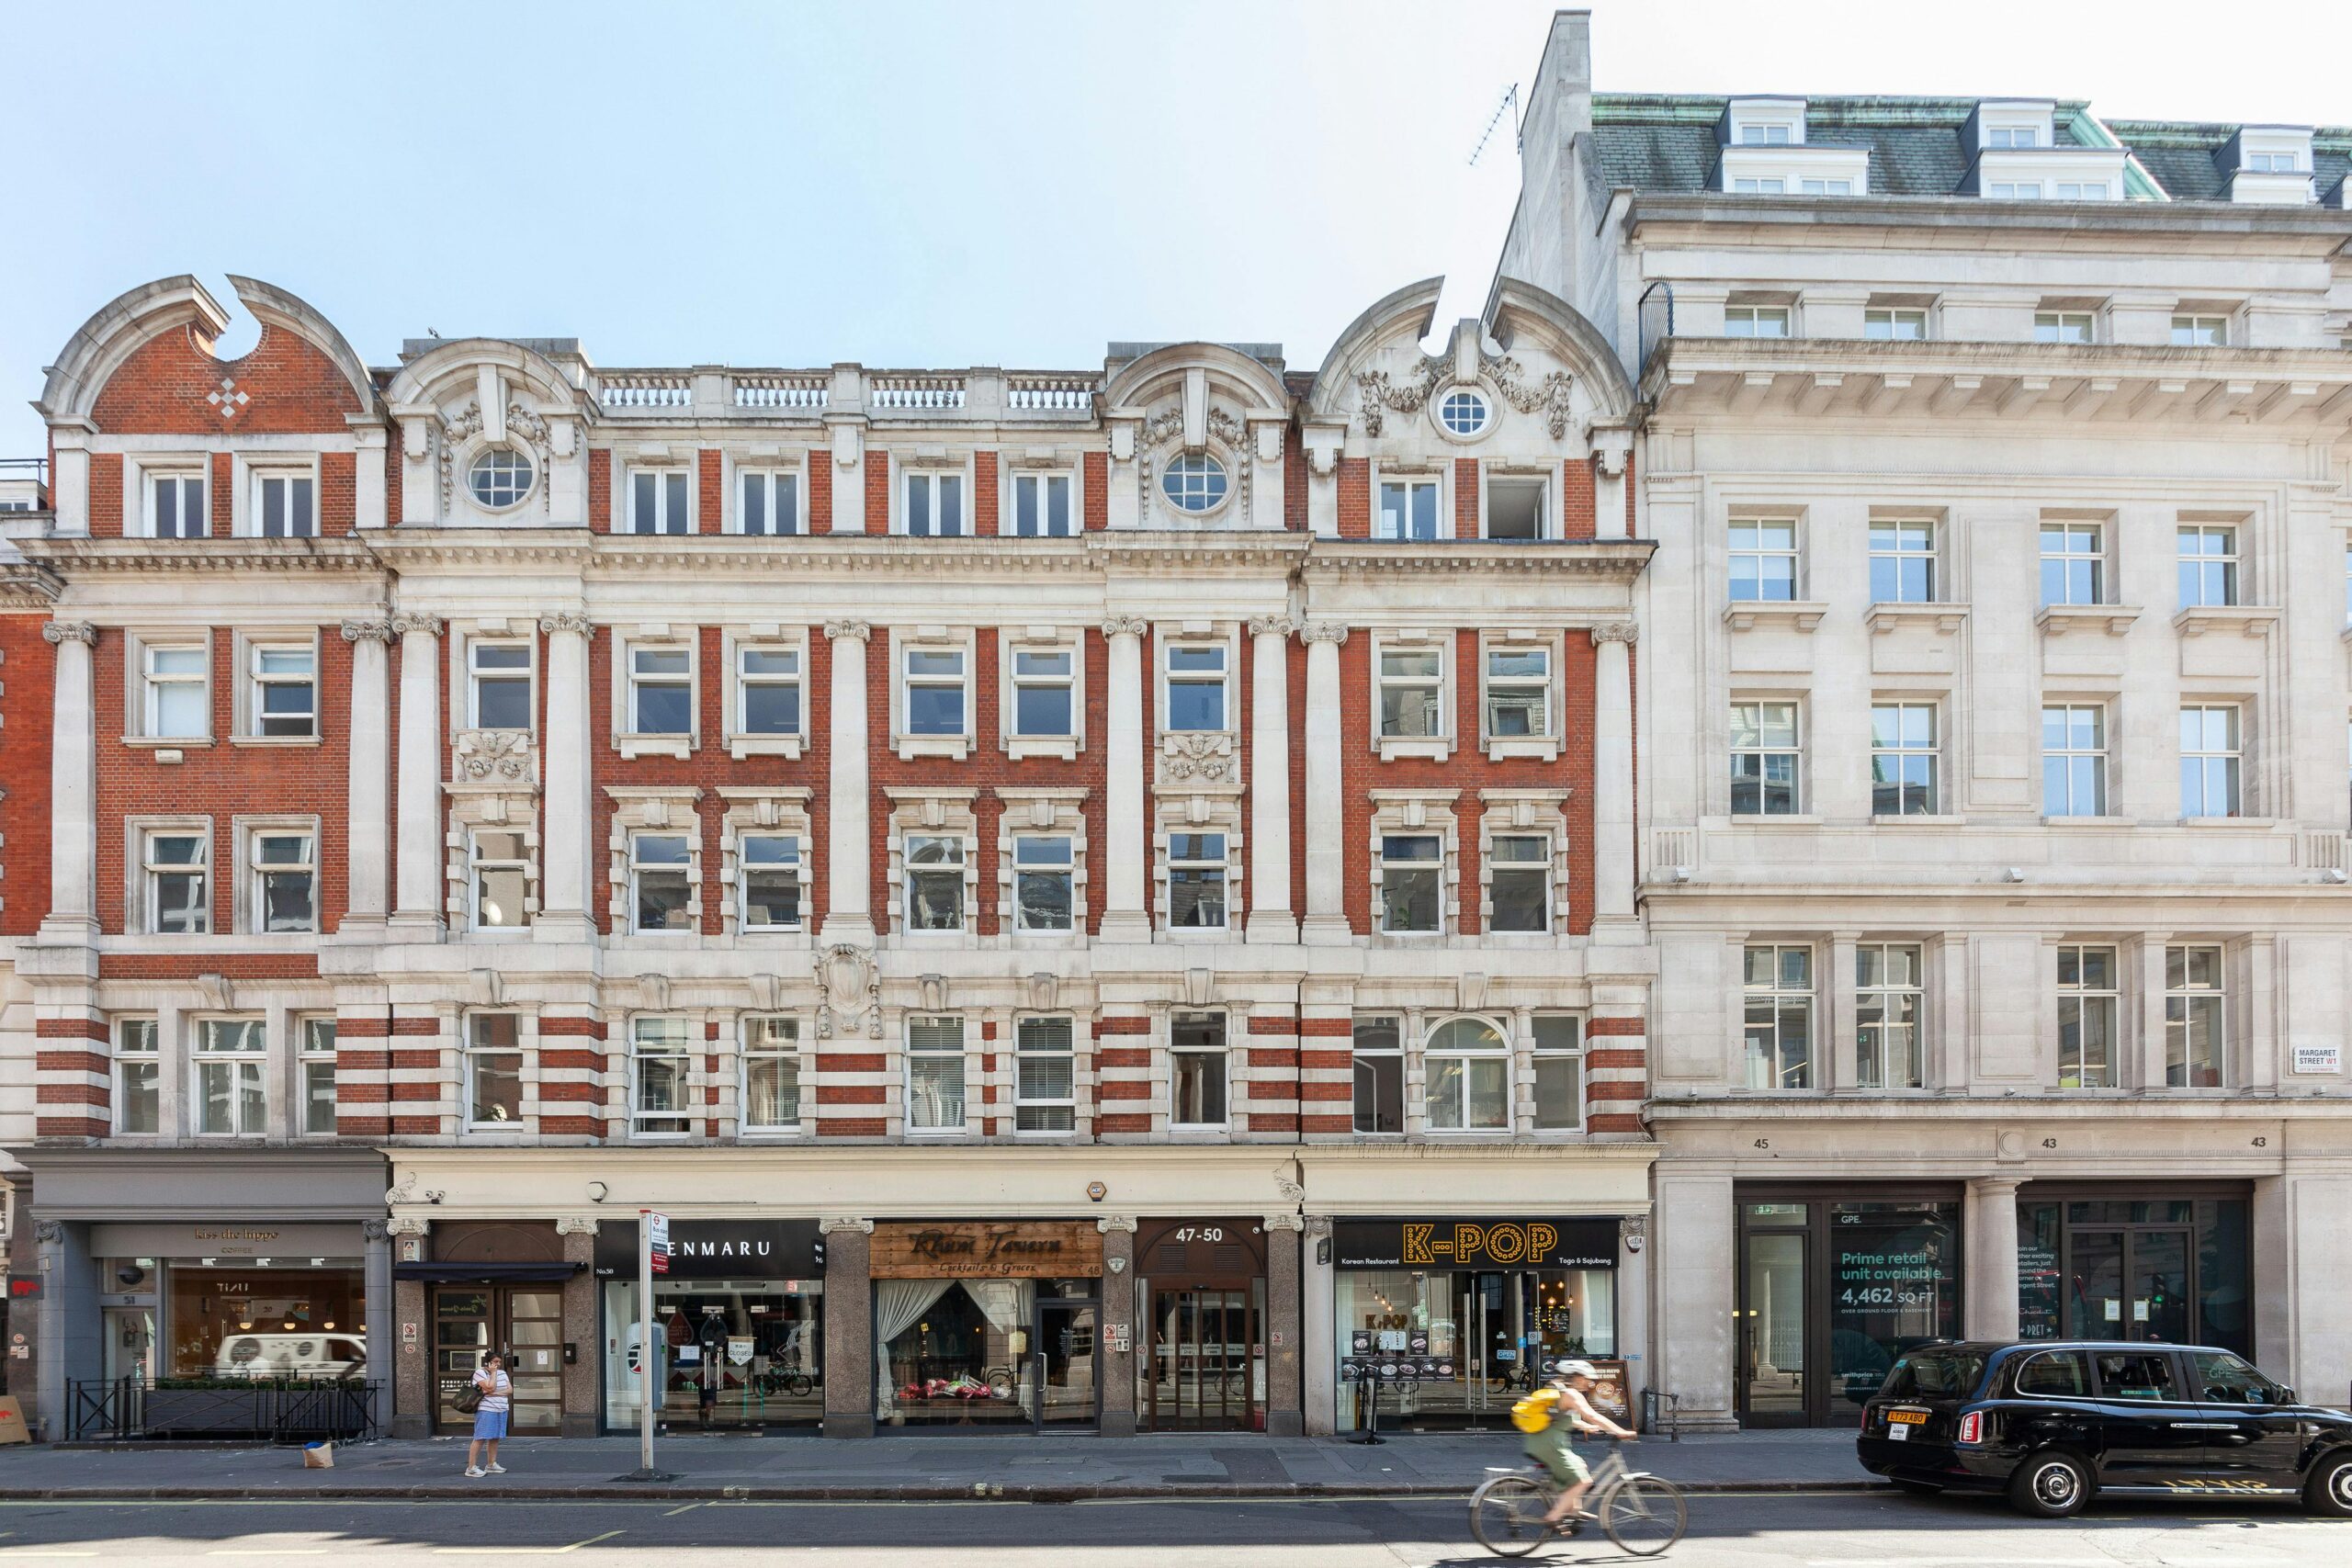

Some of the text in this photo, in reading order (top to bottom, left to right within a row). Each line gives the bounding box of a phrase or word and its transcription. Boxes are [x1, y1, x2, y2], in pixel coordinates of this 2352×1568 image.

[1754, 1138, 1770, 1149] 45
[2041, 1138, 2057, 1149] 43
[2251, 1136, 2267, 1147] 43
[1841, 1215, 1862, 1224] GPE.
[195, 1228, 280, 1243] kiss the hippo
[1175, 1227, 1223, 1242] 47-50
[667, 1241, 771, 1257] ENMARU
[985, 1230, 1061, 1261] Tavern
[1403, 1223, 1558, 1264] K-POP
[1558, 1257, 1575, 1265] Togo
[1582, 1257, 1611, 1265] Sojubang
[1841, 1252, 1928, 1265] Prime retail
[940, 1263, 989, 1272] Cocktails
[1087, 1266, 1100, 1276] 48
[1841, 1267, 1946, 1280] unit available.
[123, 1296, 135, 1304] 51
[1841, 1288, 1935, 1305] 4,462 SQ FT
[2027, 1325, 2044, 1335] PRET
